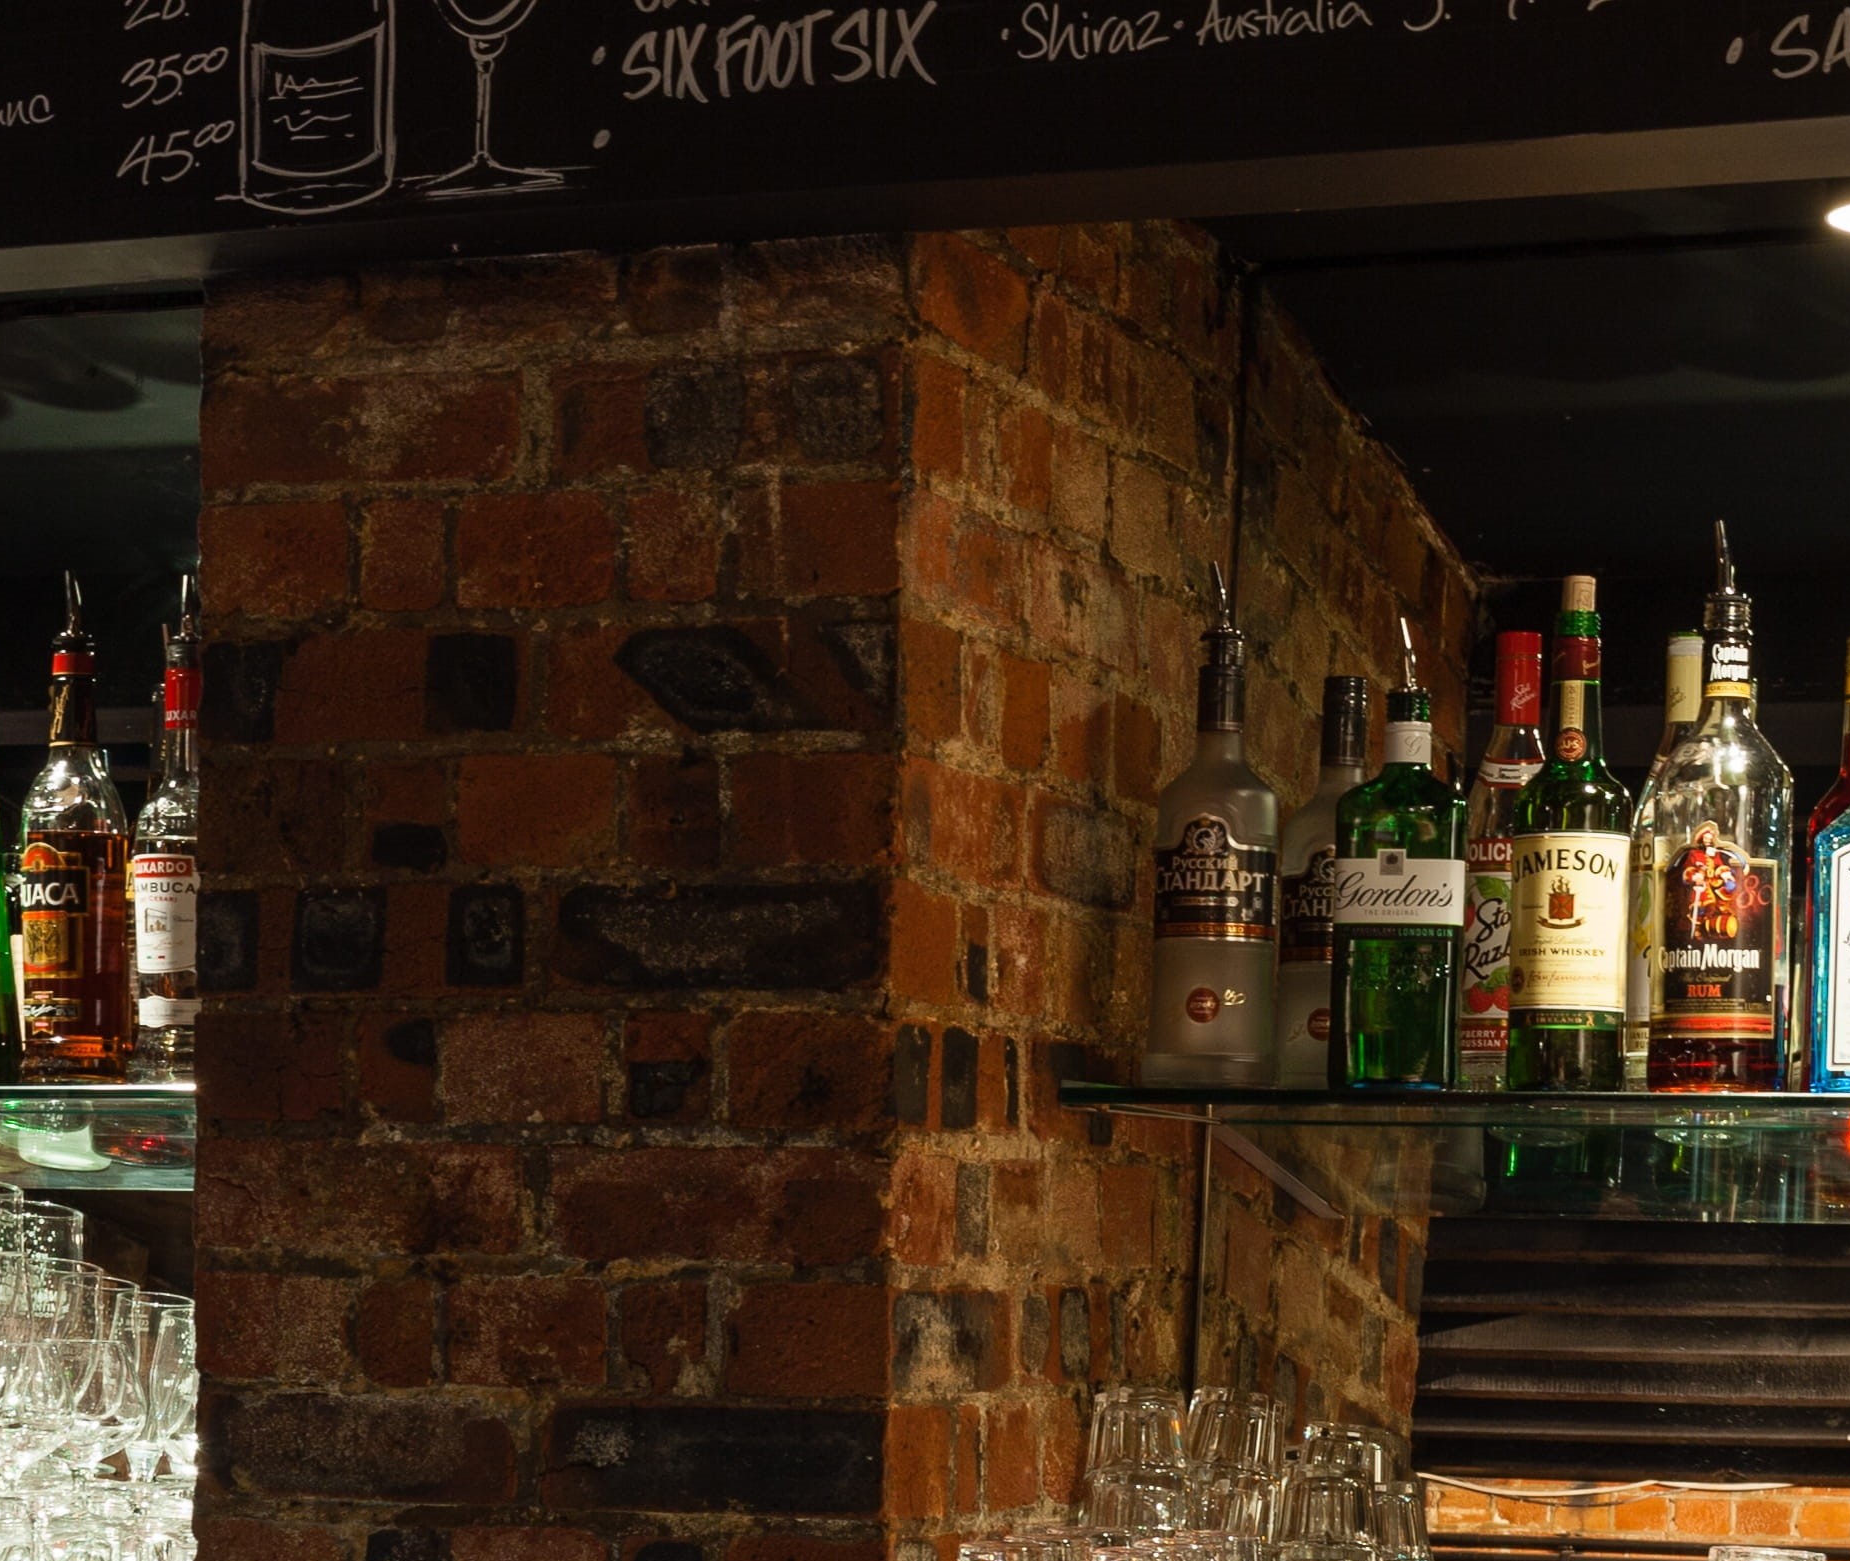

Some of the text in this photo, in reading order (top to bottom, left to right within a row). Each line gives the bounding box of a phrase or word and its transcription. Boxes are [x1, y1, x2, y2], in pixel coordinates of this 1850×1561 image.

[1018, 2, 1169, 61] Shiraz
[1196, 0, 1374, 45] Australia
[622, 0, 939, 104] SIX FOOT SIX
[121, 47, 228, 108] 35.00
[117, 120, 235, 186] 45.00
[135, 860, 187, 874] UXARDO
[1172, 854, 1239, 874] Русский
[1513, 848, 1619, 883] JAMESON
[21, 882, 80, 908] UACA
[1335, 871, 1453, 910] Gordon's
[1436, 928, 1454, 938] GIN
[1549, 947, 1606, 957] WHISKEY
[1658, 943, 1761, 972] Captain Morgan
[1686, 984, 1722, 998] RUM
